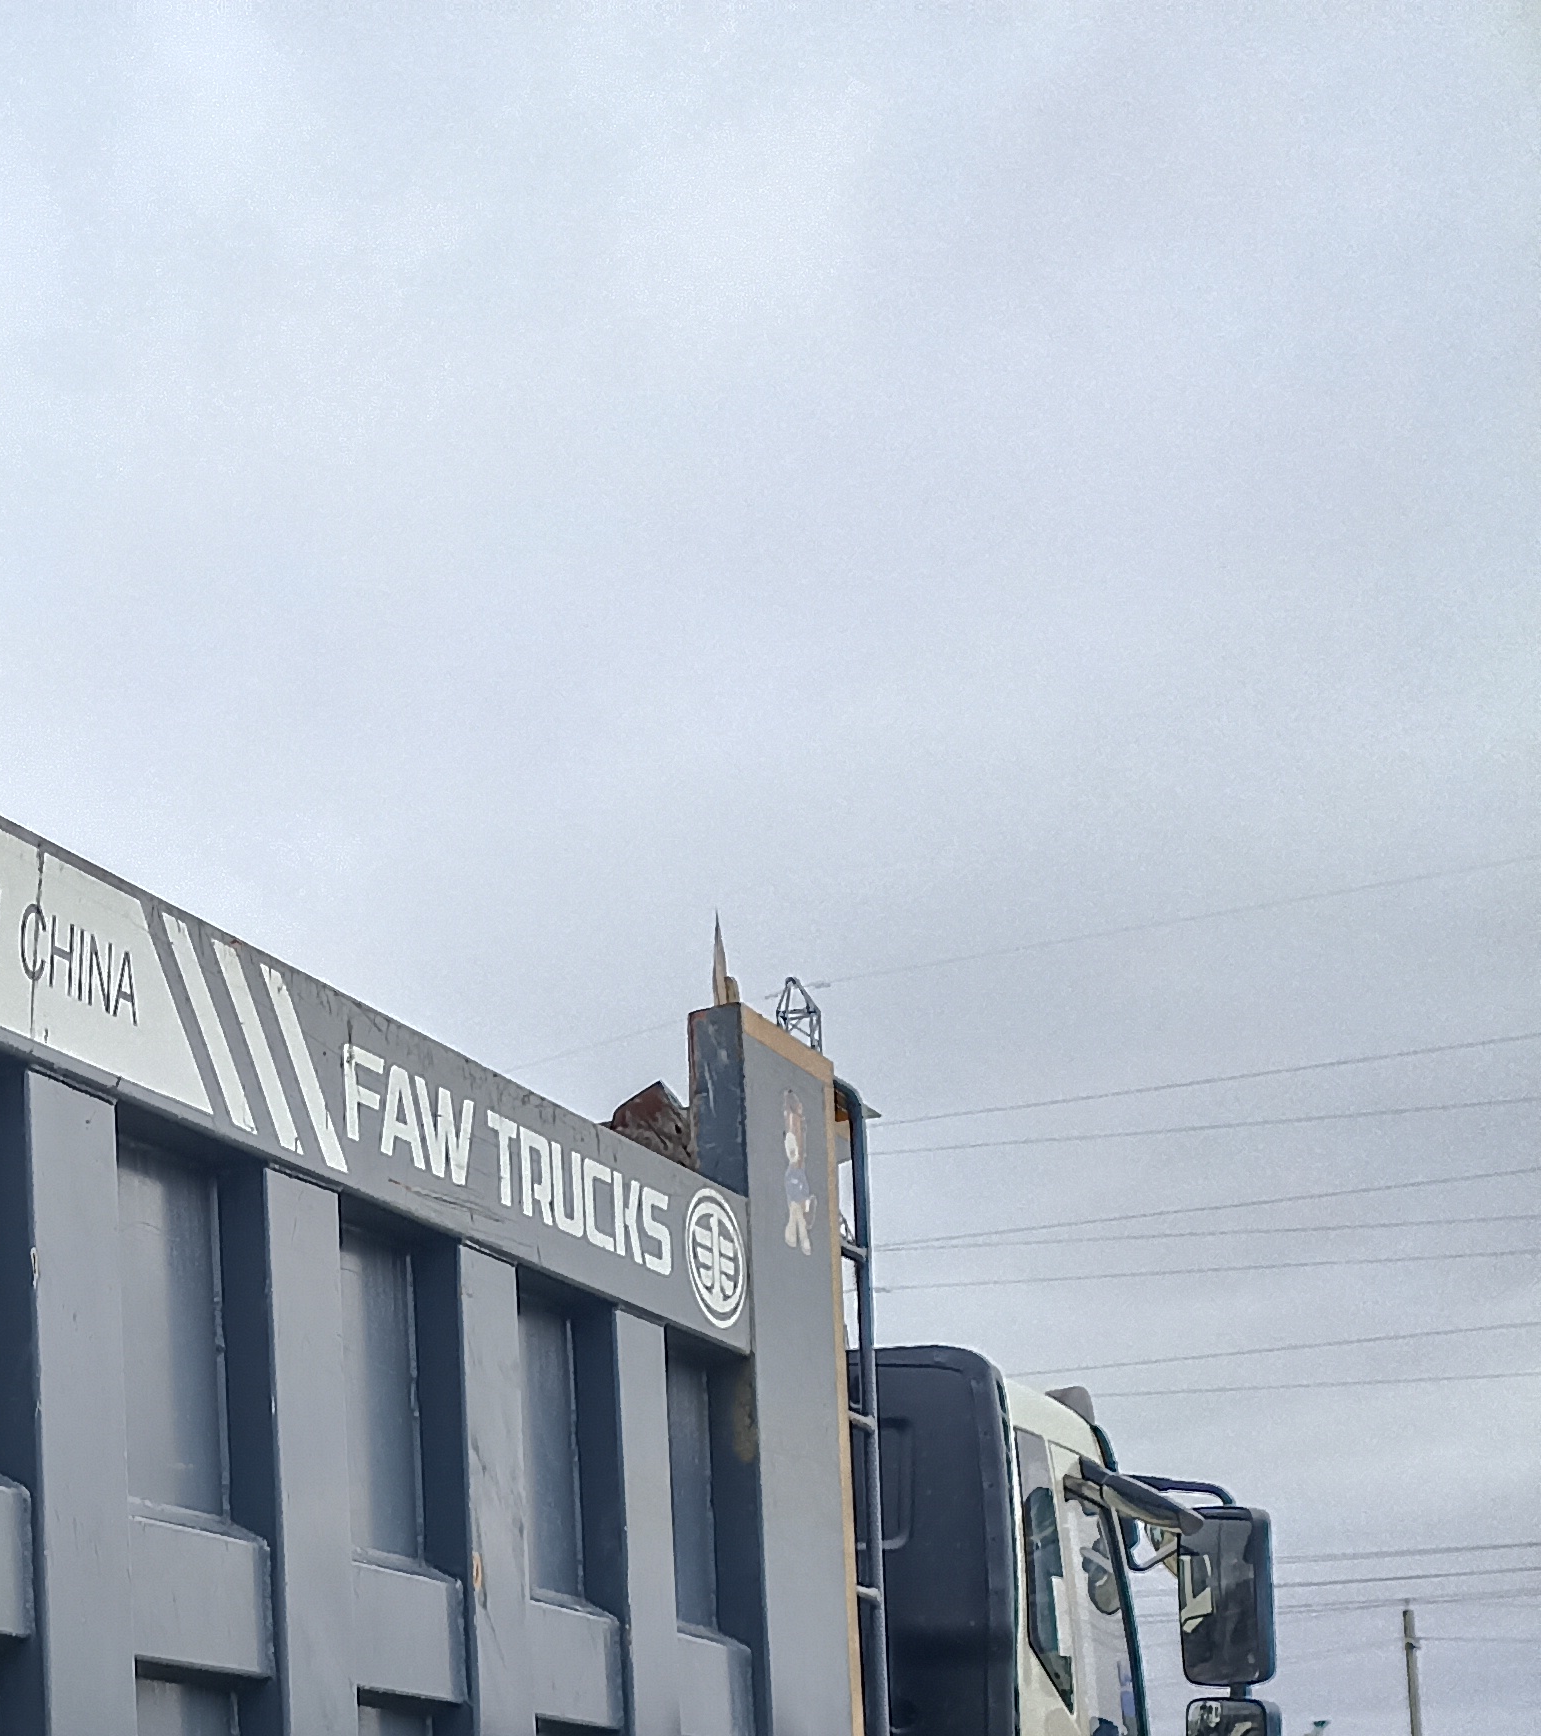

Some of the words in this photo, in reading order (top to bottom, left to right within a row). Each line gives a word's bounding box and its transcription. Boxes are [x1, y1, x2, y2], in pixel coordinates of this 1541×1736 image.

[19, 902, 139, 1027] CHINA
[343, 1042, 476, 1187] FAW
[486, 1108, 673, 1277] TRUCKS
